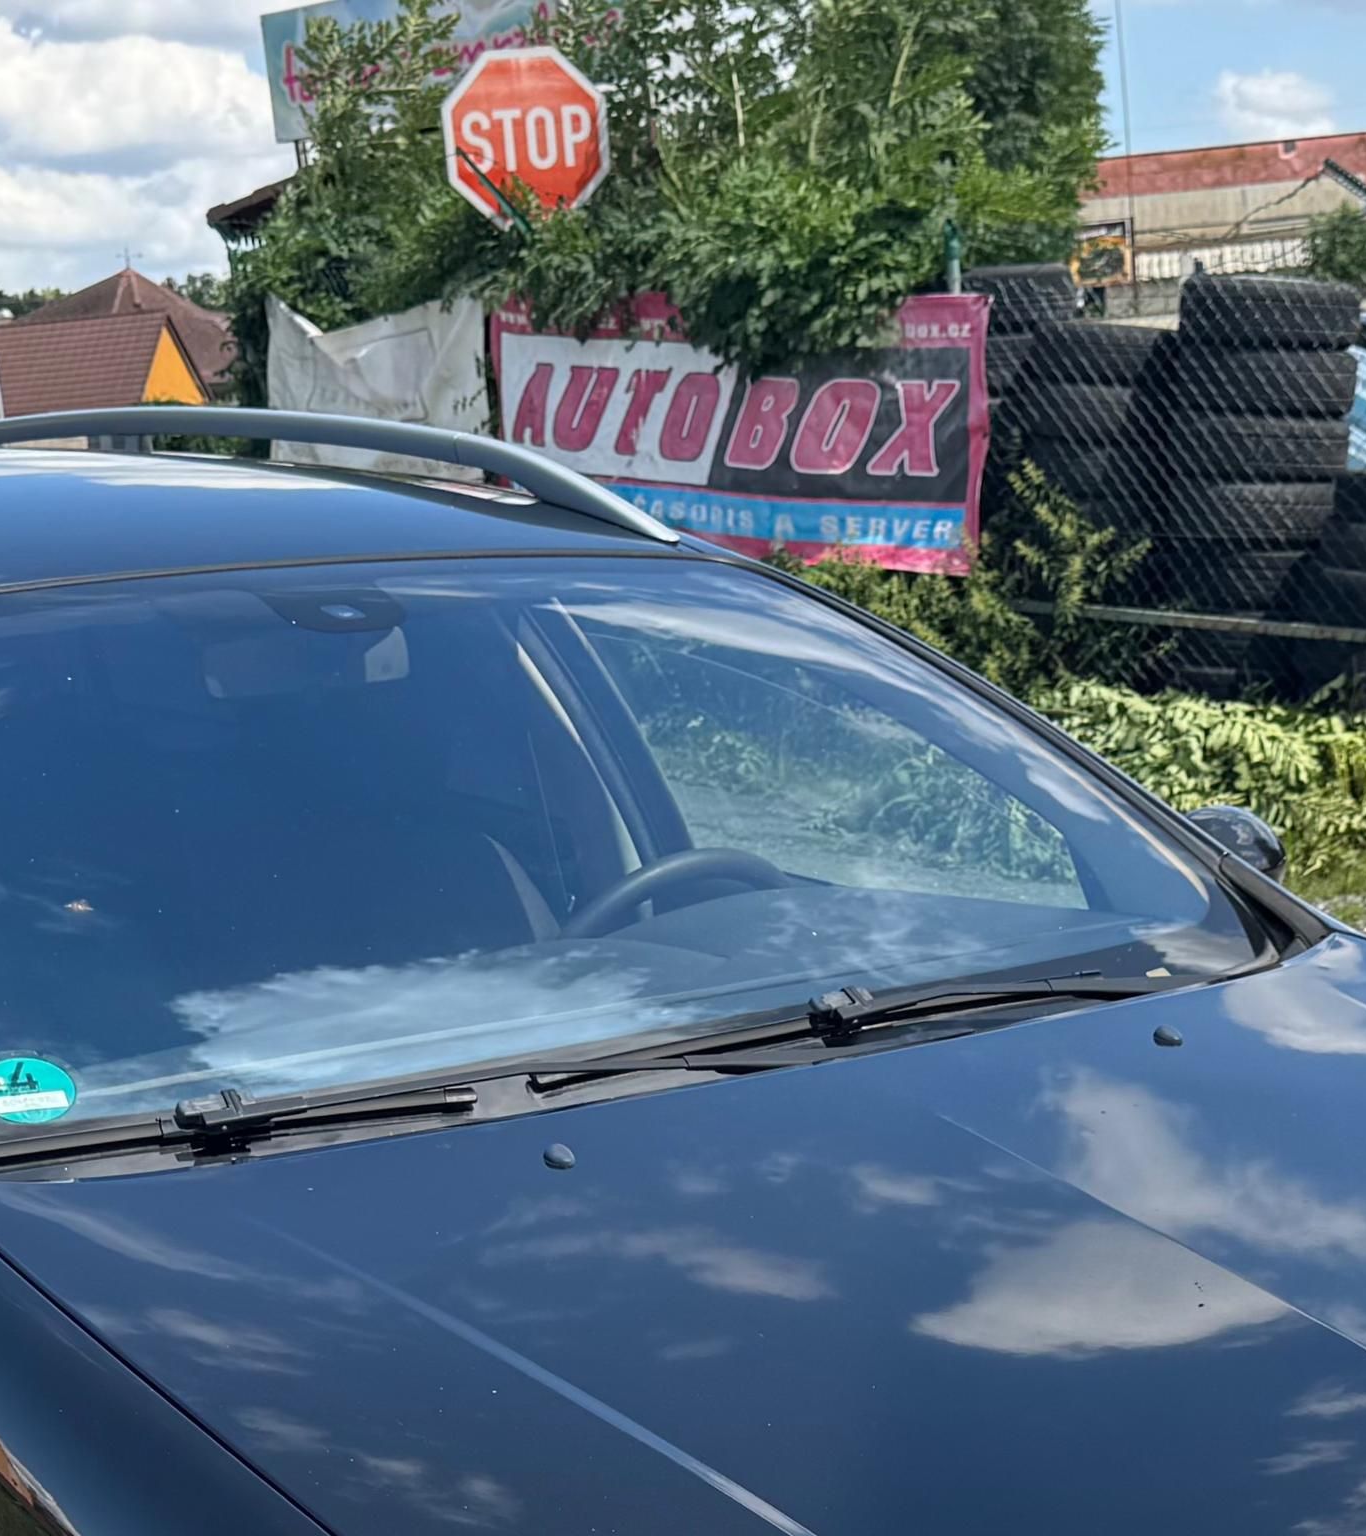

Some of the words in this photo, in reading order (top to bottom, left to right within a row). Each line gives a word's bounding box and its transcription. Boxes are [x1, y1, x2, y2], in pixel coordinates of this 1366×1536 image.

[461, 104, 592, 175] STOP
[511, 362, 961, 477] AUTOBOX
[819, 514, 954, 542] SERVER
[10, 1061, 37, 1091] 4
